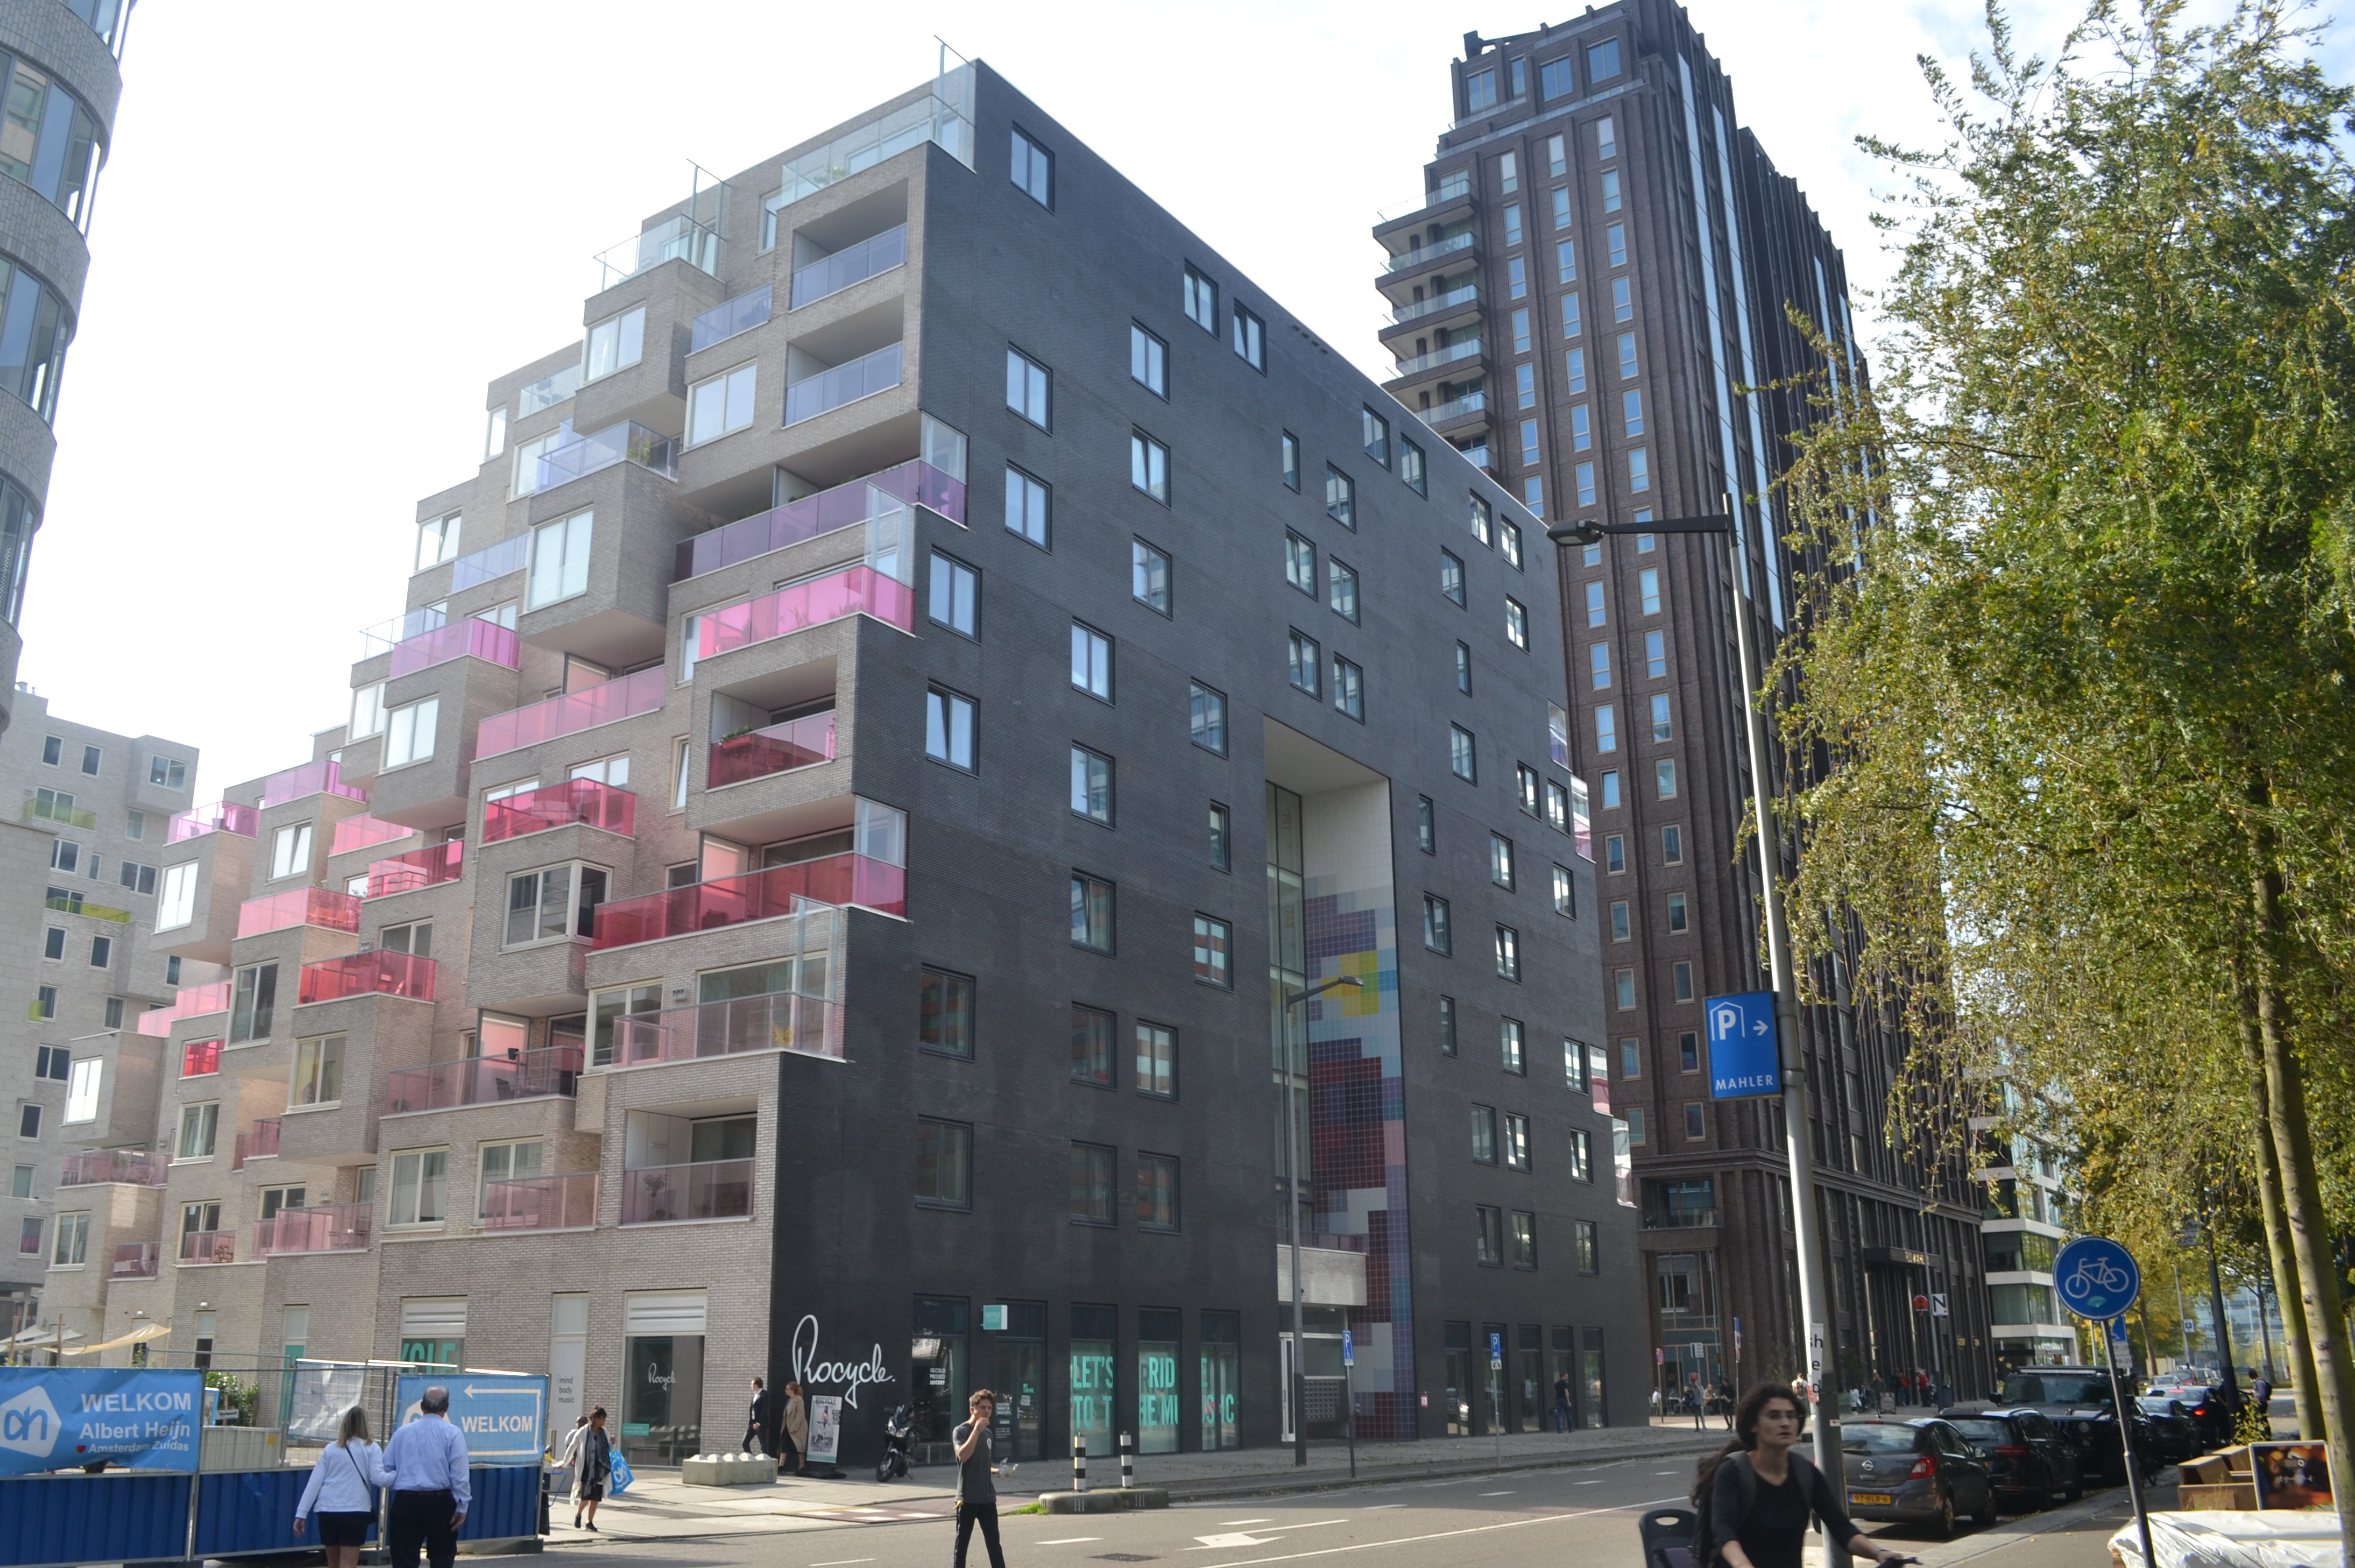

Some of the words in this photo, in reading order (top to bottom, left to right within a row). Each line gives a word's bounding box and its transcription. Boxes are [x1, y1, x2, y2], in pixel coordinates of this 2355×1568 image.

[1717, 1009, 1737, 1040] P
[1715, 1075, 1773, 1091] MAHLER
[559, 1386, 572, 1394] body
[81, 1392, 192, 1413] WELKOM
[79, 1422, 139, 1439] Albert
[145, 1421, 190, 1440] Heijn
[461, 1416, 533, 1433] WELKOM
[88, 1443, 150, 1454] Amsterdam
[151, 1440, 189, 1452] Zuidas
